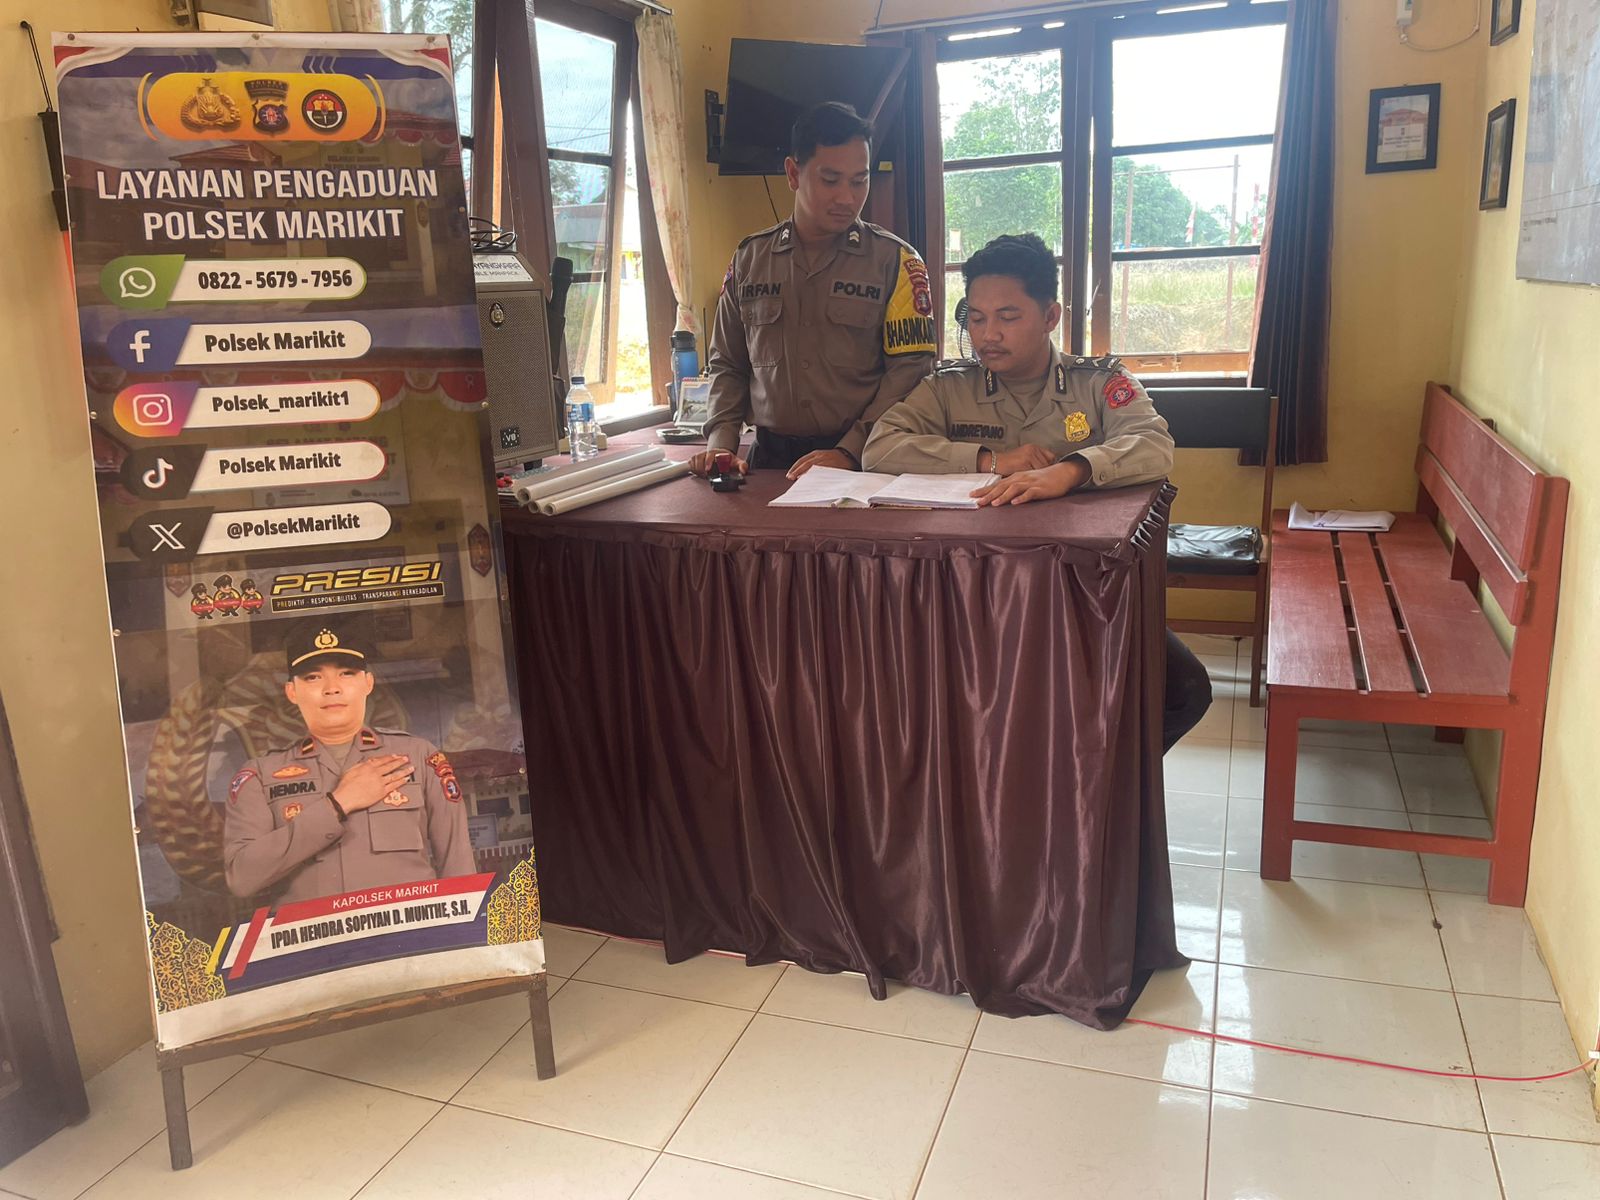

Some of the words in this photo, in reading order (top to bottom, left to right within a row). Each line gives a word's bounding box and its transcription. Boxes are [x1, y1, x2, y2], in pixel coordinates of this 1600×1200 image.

[97, 168, 244, 200] LAYANAN
[255, 167, 438, 199] PENGADUAN
[143, 210, 269, 241] POLSEK
[276, 208, 404, 240] MARIKIT
[198, 271, 242, 290] 0822
[256, 271, 298, 289] 5679
[311, 269, 353, 288] 7956
[742, 282, 782, 298] IRFAN
[833, 281, 881, 300] POLRI
[205, 332, 270, 352] Polsek
[274, 330, 346, 350] Marikit
[212, 390, 350, 413] Polsek_marikit1
[219, 455, 276, 474] Polsek
[279, 452, 342, 472] Marikit
[227, 513, 360, 539] @PolsekMarikit
[272, 563, 442, 593] PRESISI
[276, 599, 305, 608] PREDIKTIF
[402, 587, 438, 597] BERKEADILAN
[270, 781, 316, 799] HENDRA
[332, 890, 392, 909] KAPOLSEK
[395, 883, 440, 900] MARIKIT
[271, 928, 299, 950] IPDA
[300, 921, 345, 945] HENDRA
[345, 911, 392, 936] SOPIYAN
[393, 909, 405, 925] D.
[405, 902, 451, 924] MUNTHE,
[451, 899, 472, 917] S.H.
